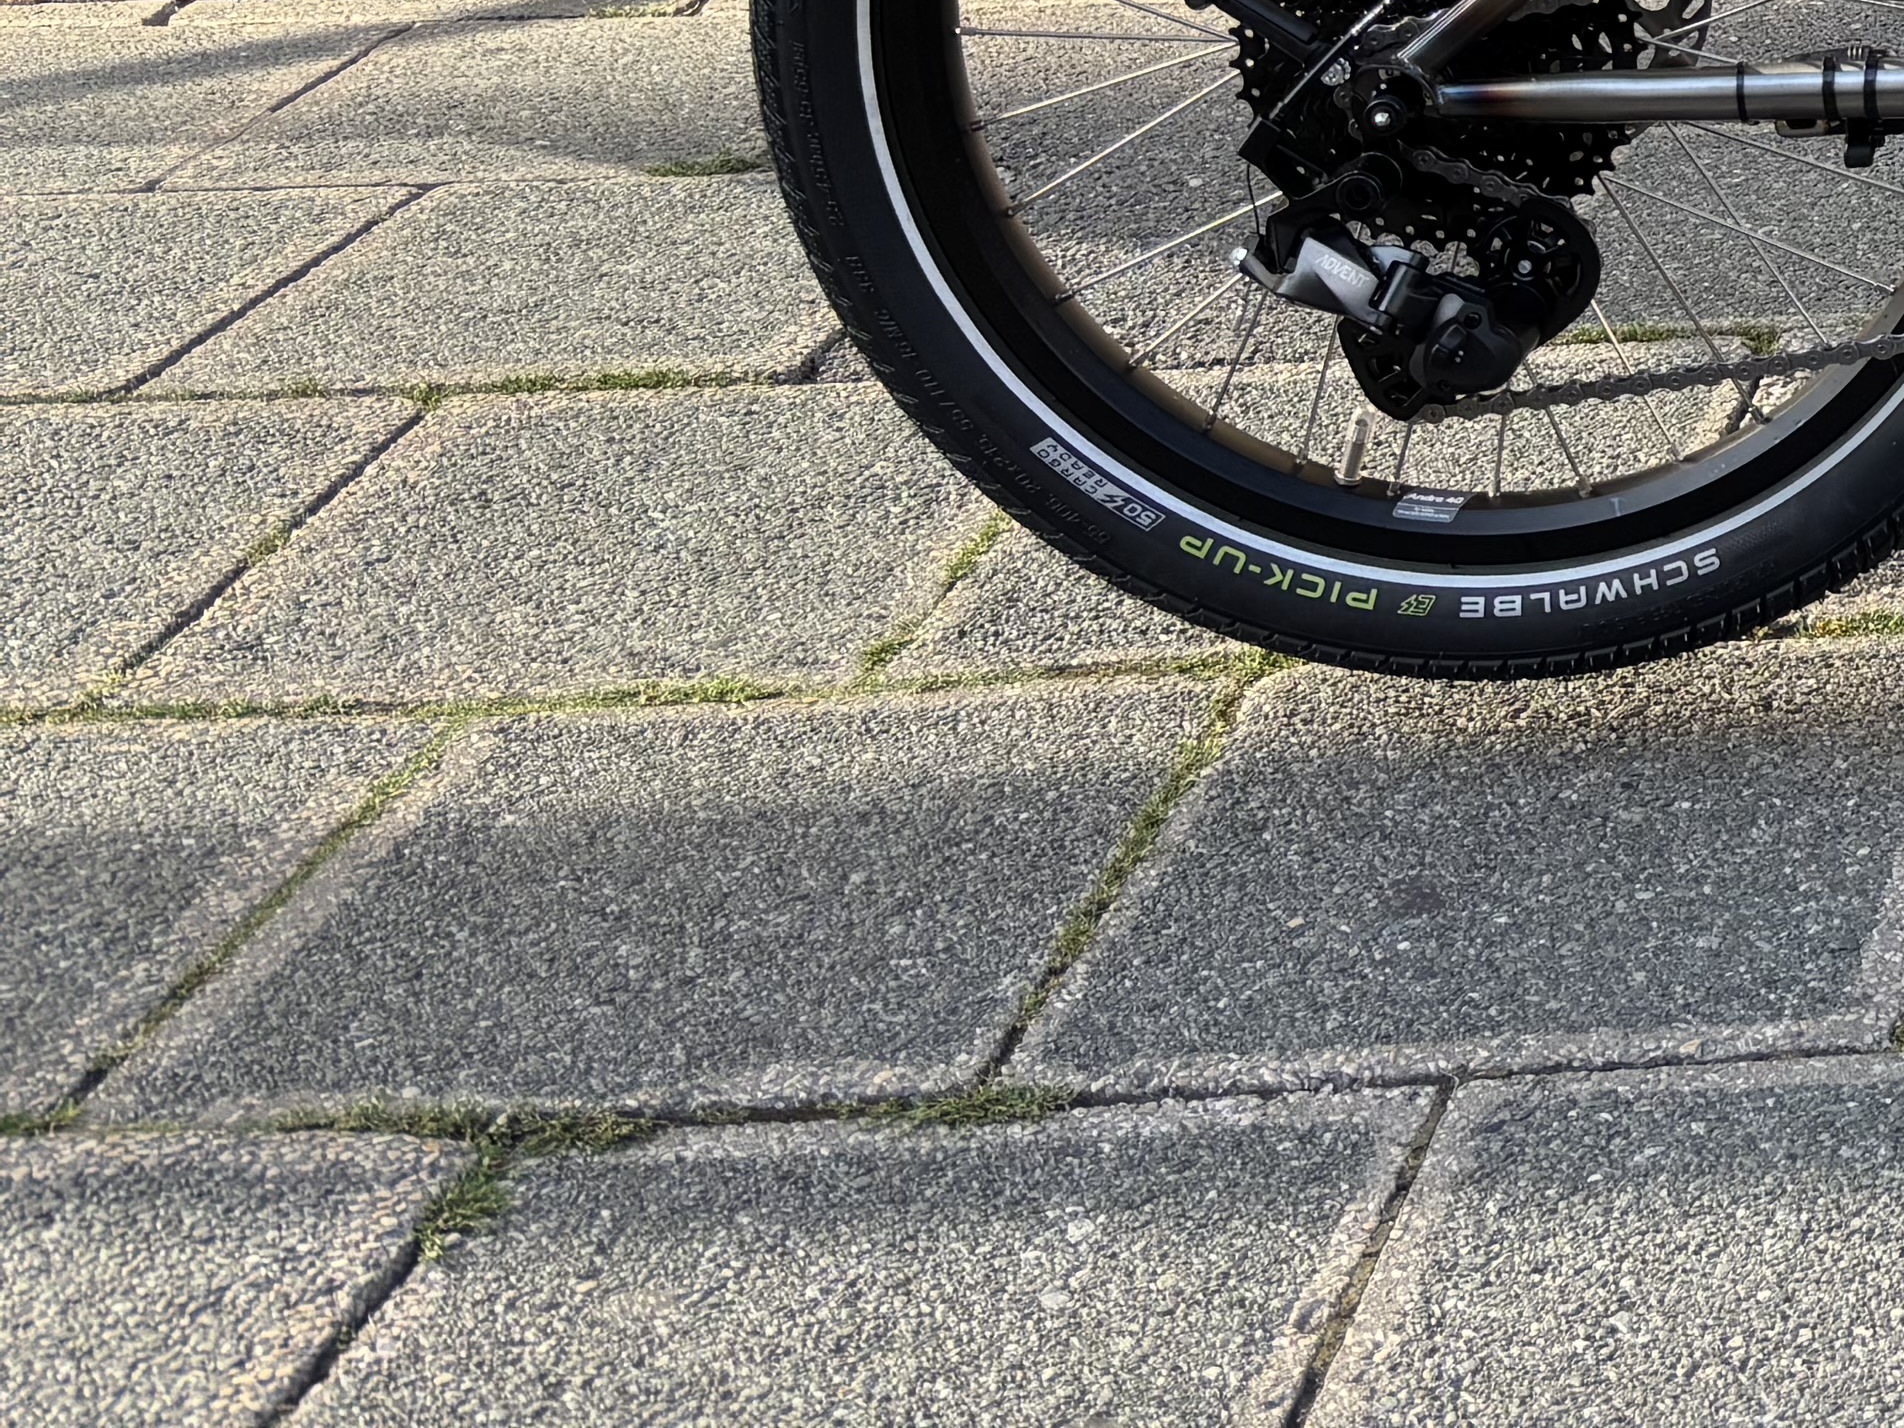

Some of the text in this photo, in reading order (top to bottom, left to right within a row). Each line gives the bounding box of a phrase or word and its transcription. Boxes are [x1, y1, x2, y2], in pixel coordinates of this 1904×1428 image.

[1315, 254, 1370, 287] ADVENT
[1037, 445, 1102, 496] CARGO
[1047, 444, 1107, 487] READY
[1124, 503, 1159, 526] 50
[1180, 535, 1378, 610] PICK-UP
[1460, 548, 1721, 618] SCHWALBE
